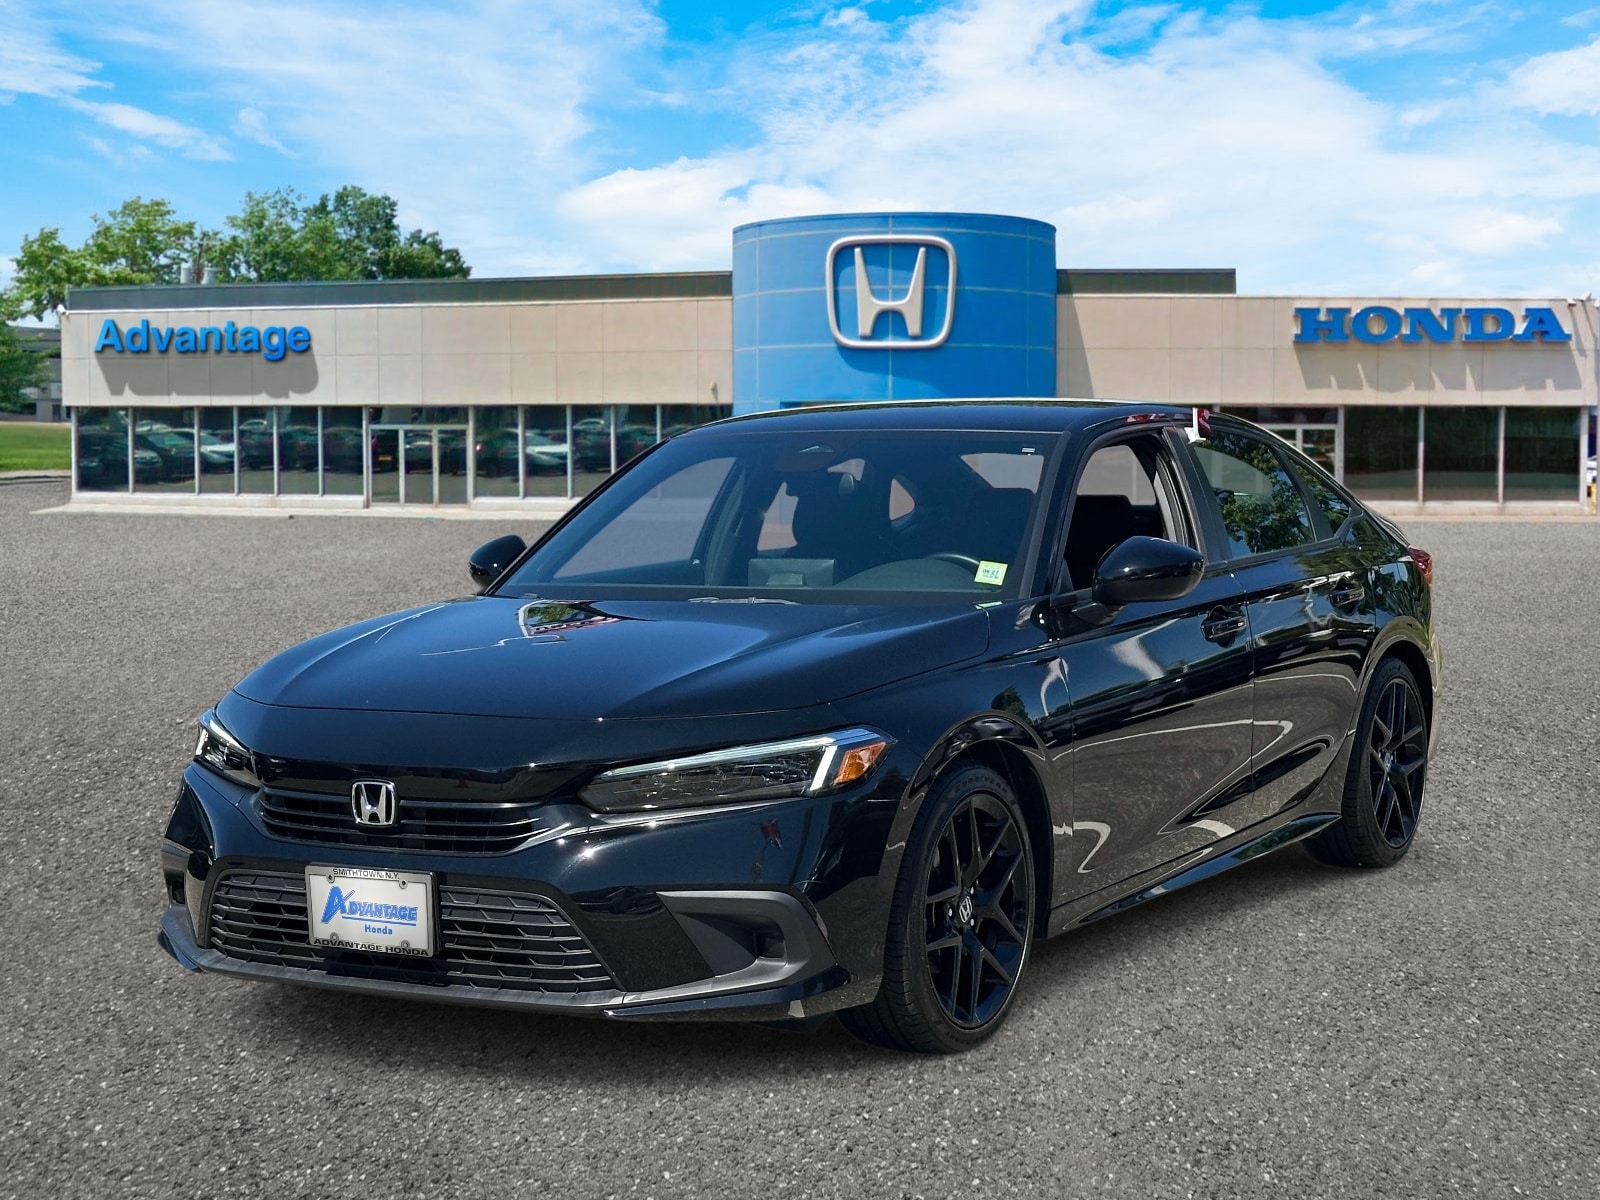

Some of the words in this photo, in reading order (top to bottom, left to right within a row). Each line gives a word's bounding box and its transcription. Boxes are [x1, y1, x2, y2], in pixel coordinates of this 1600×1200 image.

[1294, 305, 1573, 343] HONDA
[95, 319, 312, 361] Advantage
[364, 924, 393, 935] Honda
[313, 938, 384, 952] ADVANTAGE
[385, 943, 429, 957] HONDA
